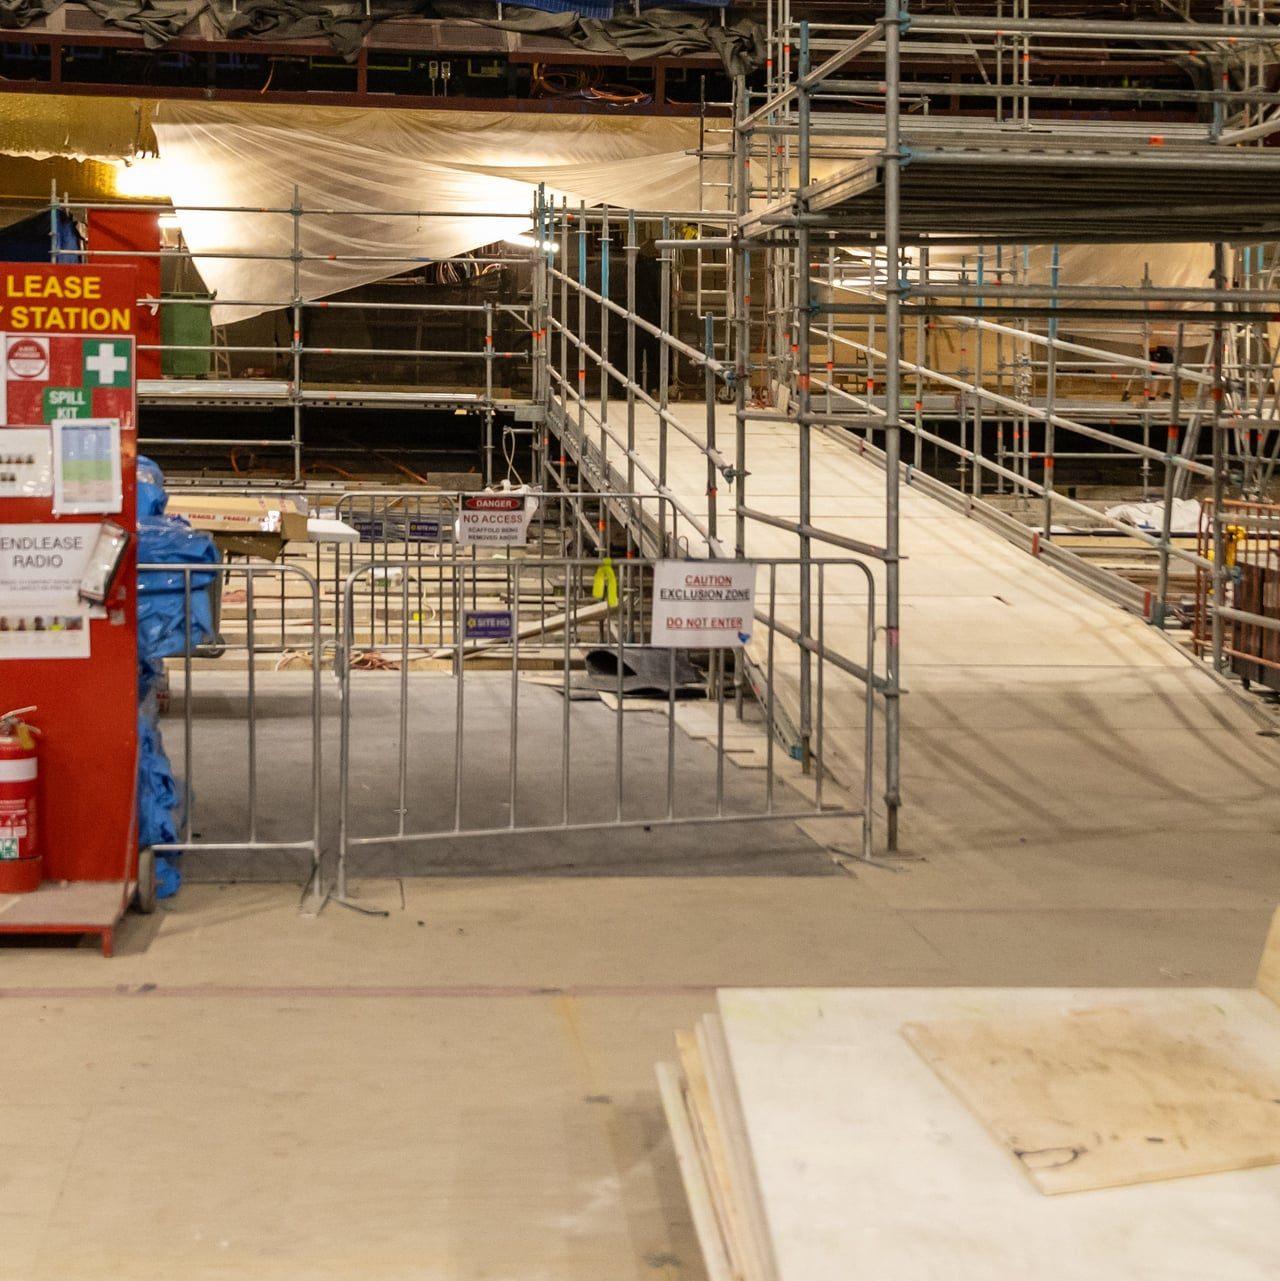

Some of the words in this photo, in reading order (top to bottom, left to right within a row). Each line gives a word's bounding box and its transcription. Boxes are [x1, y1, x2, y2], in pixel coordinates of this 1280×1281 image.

[7, 275, 102, 299] LEASE
[11, 306, 131, 330] STATION
[48, 390, 86, 405] SPILL
[57, 407, 79, 419] KIT
[476, 500, 512, 508] DANGER
[463, 515, 480, 523] NO
[481, 514, 523, 524] ACCESS
[12, 554, 64, 569] RADIO
[685, 574, 733, 586] CAUTION
[660, 588, 723, 600] EXCLUSION
[725, 588, 751, 601] ZONE
[666, 617, 683, 629] DO
[686, 617, 708, 628] NOT
[710, 617, 743, 629] ENTER
